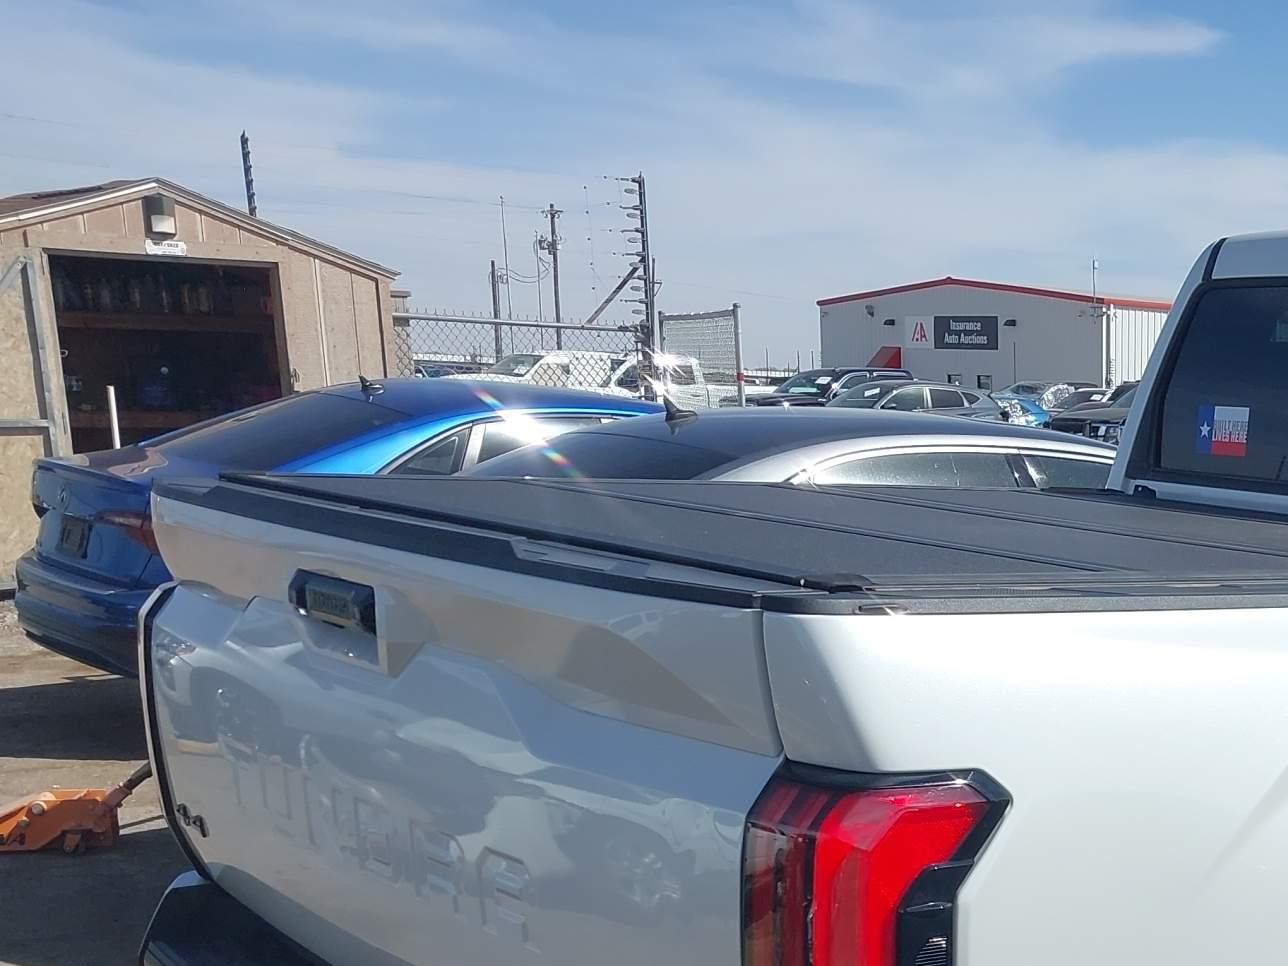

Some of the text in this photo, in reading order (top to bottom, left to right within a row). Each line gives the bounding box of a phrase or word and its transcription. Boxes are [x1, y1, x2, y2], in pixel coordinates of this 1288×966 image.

[949, 319, 982, 331] Insurance
[944, 332, 988, 345] Auto Auctions
[1212, 430, 1247, 443] LIVES HERE
